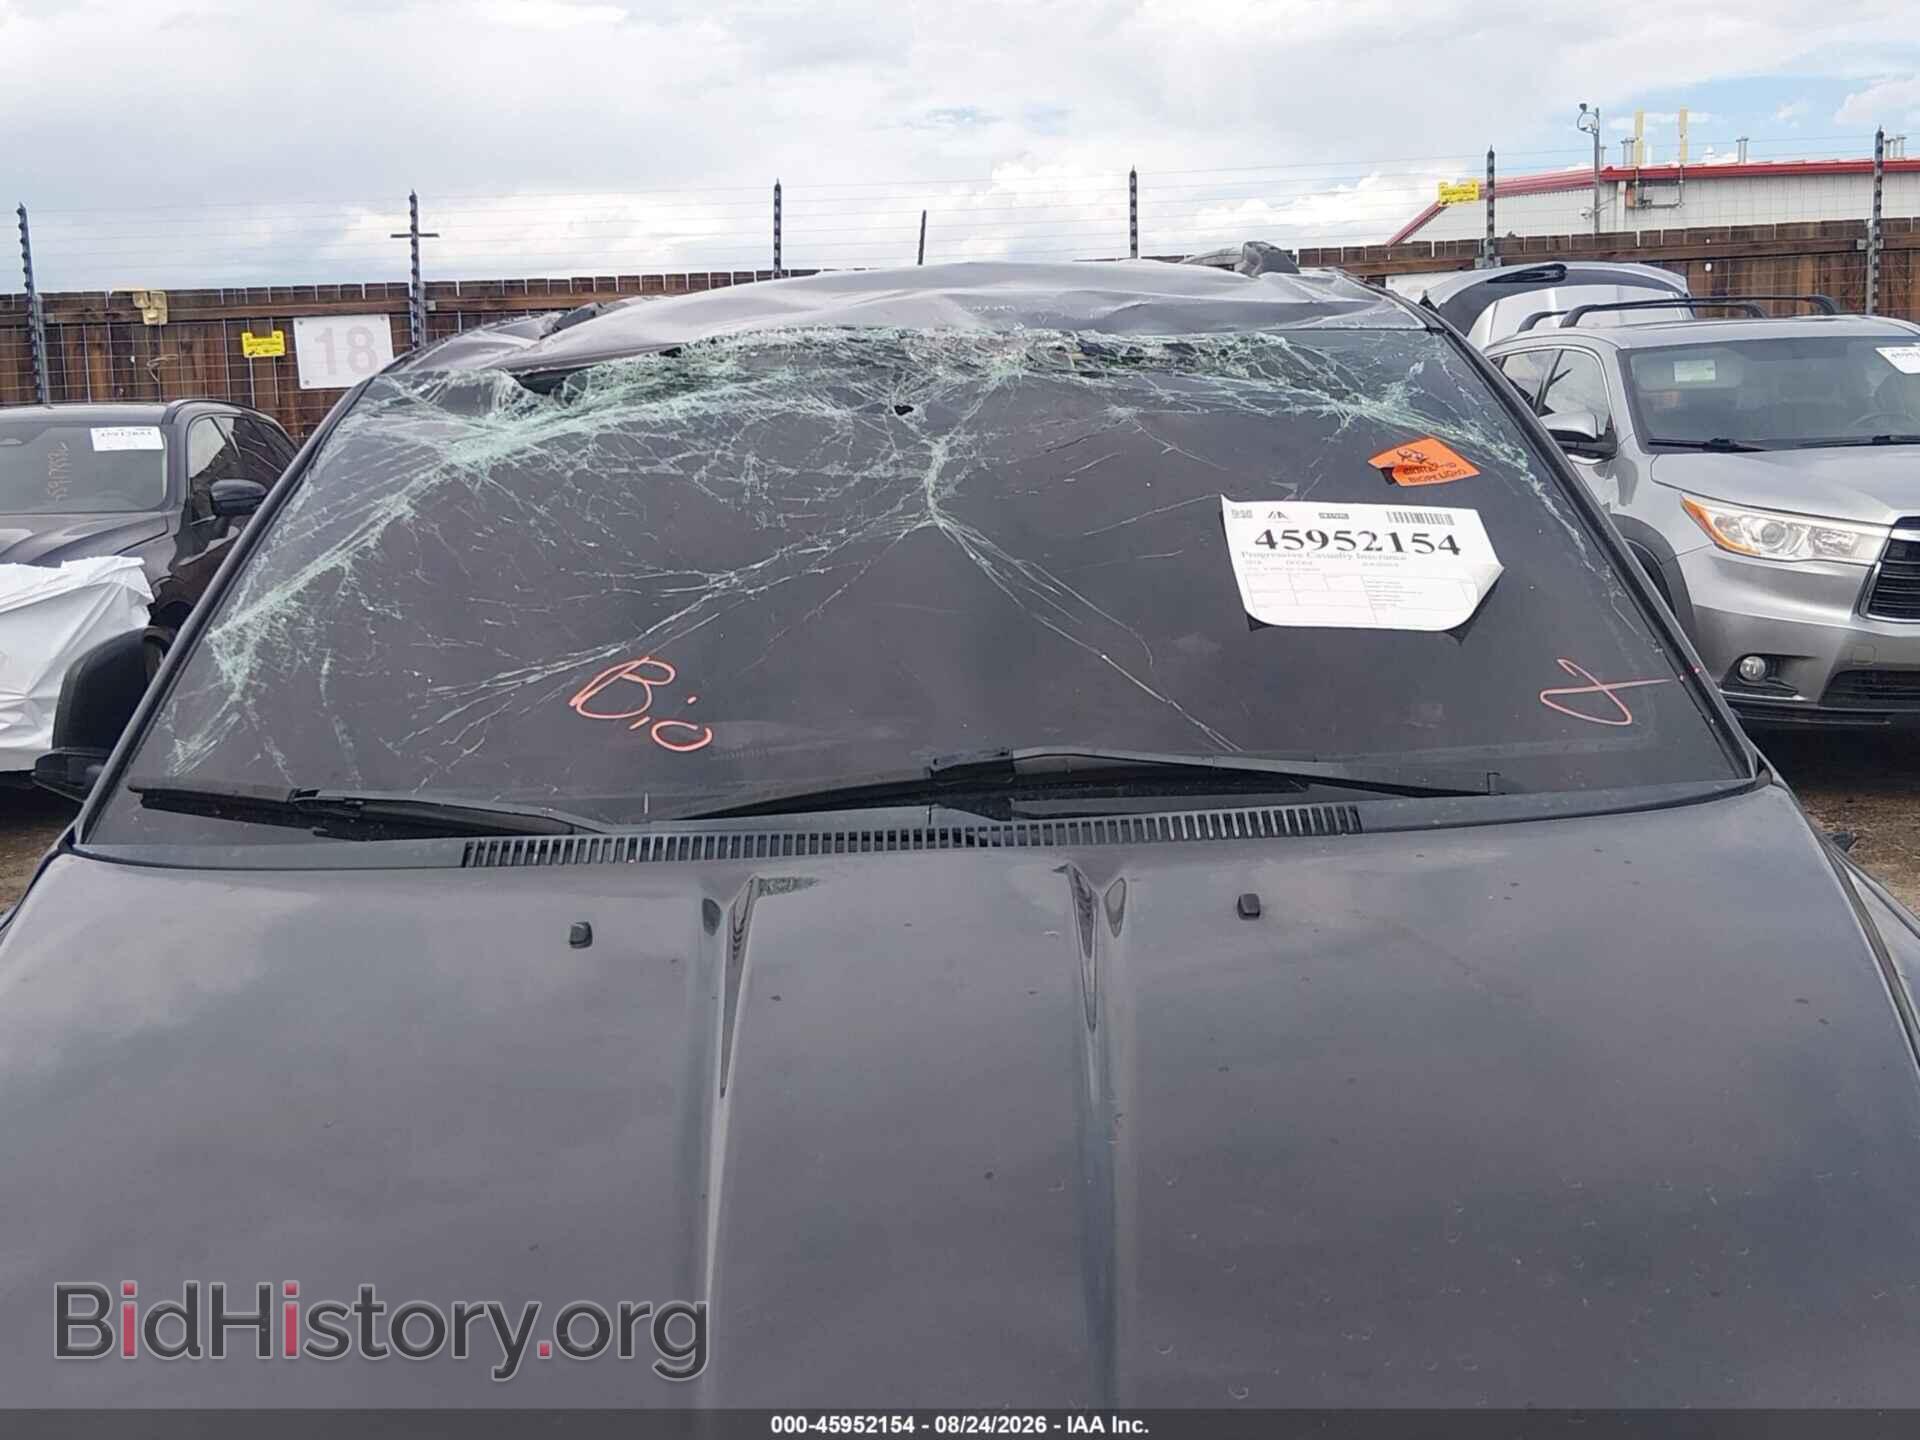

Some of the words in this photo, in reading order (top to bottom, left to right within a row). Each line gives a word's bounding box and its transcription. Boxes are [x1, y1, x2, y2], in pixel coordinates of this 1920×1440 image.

[314, 326, 378, 375] 18
[1255, 529, 1461, 555] 45952154
[1241, 551, 1303, 561] Progressive
